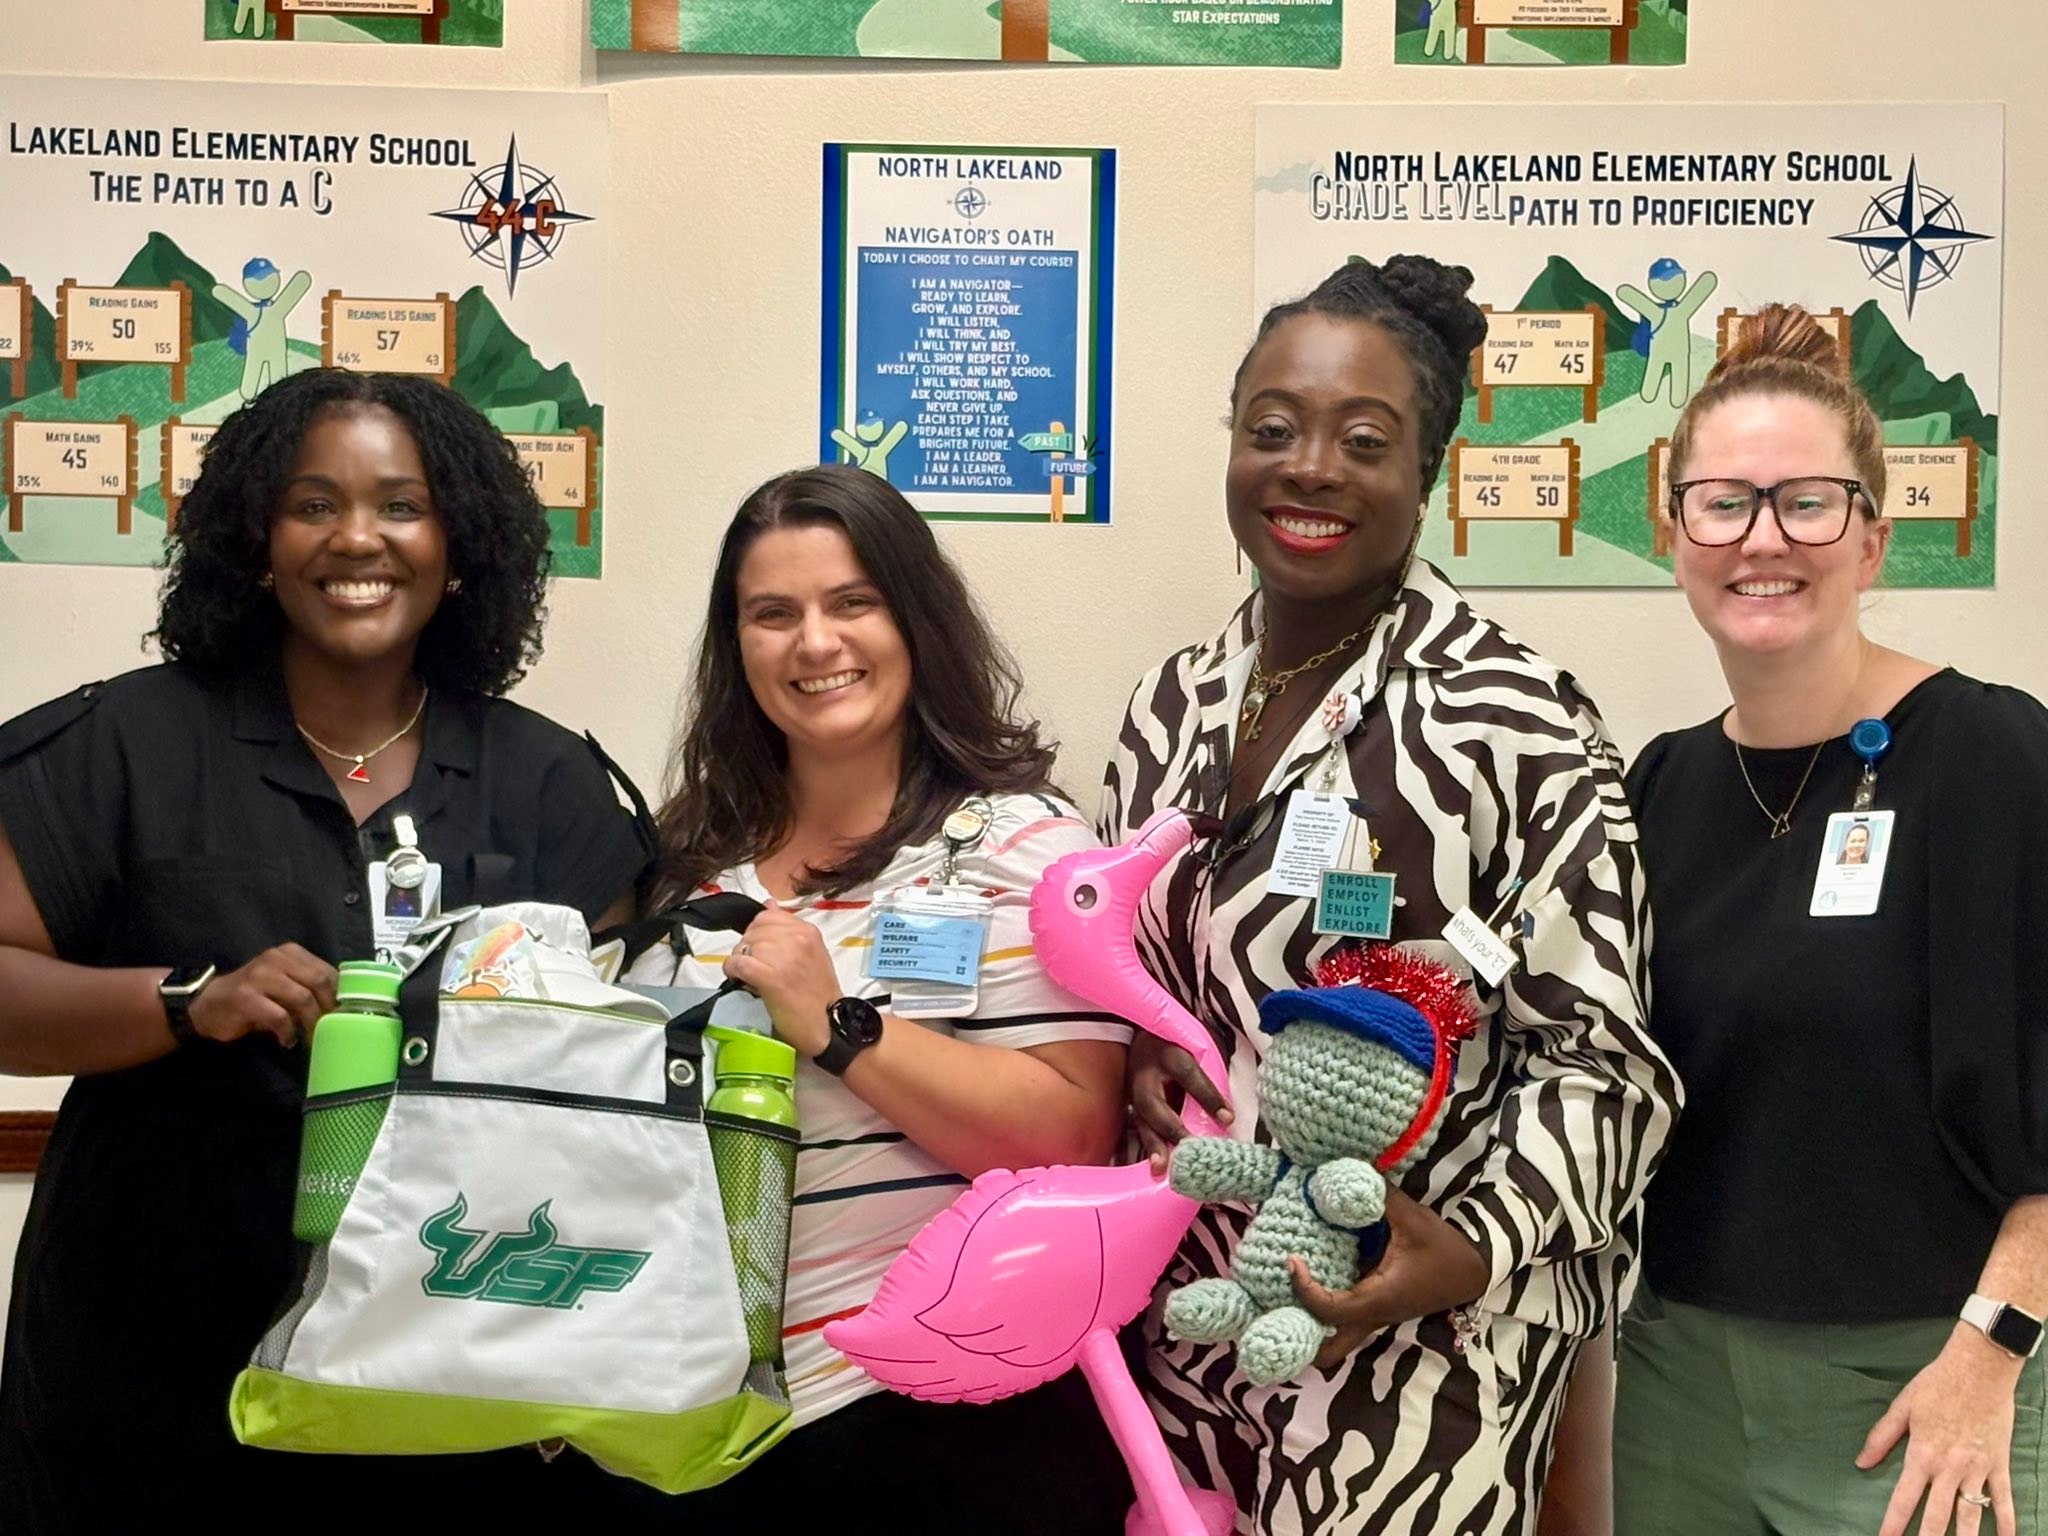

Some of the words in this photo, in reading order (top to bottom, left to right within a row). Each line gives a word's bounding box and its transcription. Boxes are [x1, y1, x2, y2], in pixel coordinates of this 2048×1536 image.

[1172, 10, 1200, 24] STAR
[1202, 11, 1280, 24] EXPECTATIONS
[10, 124, 160, 158] LAKELAND
[172, 128, 359, 164] ELEMENTARY
[370, 134, 476, 168] SCHOOL
[879, 158, 948, 178] NORTH
[957, 159, 1062, 180] LAKELAND
[1335, 152, 1423, 182] NORTH
[1434, 152, 1581, 182] LAKELAND
[1593, 152, 1776, 182] ELEMENTARY
[1787, 152, 1892, 182] SCHOOL
[90, 170, 142, 203] THE
[154, 172, 223, 205] PATH
[235, 178, 268, 206] TO
[280, 180, 298, 208] A
[313, 168, 332, 214] C
[1310, 173, 1408, 220] GRADE
[1420, 181, 1507, 221] LEVEL
[1510, 196, 1578, 226] PATH
[1589, 198, 1621, 226] TO
[1633, 196, 1814, 226] PROFICIENCY
[477, 200, 523, 236] 44
[534, 200, 556, 236] C
[886, 227, 1000, 244] NAVIGATOR'S
[1008, 230, 1054, 246] OATH
[864, 253, 899, 264] TODAY
[902, 254, 906, 264] I
[909, 254, 951, 265] CHOOSE
[954, 255, 969, 265] TO
[972, 255, 1007, 266] CHART
[1010, 256, 1027, 266] MY
[912, 279, 916, 289] I
[919, 279, 936, 290] AM
[939, 279, 947, 290] A
[921, 291, 955, 302] READY
[958, 292, 973, 302] TO
[90, 297, 128, 309] READING
[131, 298, 158, 310] GAINS
[952, 304, 973, 315] AND
[347, 309, 386, 320] READING
[388, 310, 406, 321] L25
[408, 311, 436, 322] GAINS
[930, 316, 935, 326] I
[937, 316, 961, 327] WILL
[112, 318, 135, 339] 50
[1530, 319, 1562, 330] PERIOD
[919, 328, 924, 338] I
[926, 328, 950, 339] WILL
[989, 329, 1011, 340] AND
[71, 340, 94, 352] 39%
[377, 330, 400, 351] 57
[914, 340, 919, 351] I
[922, 340, 945, 351] WILL
[948, 341, 968, 351] TRY
[971, 341, 988, 352] MY
[1488, 340, 1517, 348] READING
[1519, 340, 1534, 348] ACH
[1554, 340, 1574, 348] MATH
[1576, 340, 1590, 348] ACH
[155, 342, 172, 354] 155
[337, 351, 360, 364] 46%
[426, 354, 440, 366] 43
[900, 352, 904, 363] I
[907, 353, 931, 363] WILL
[934, 353, 965, 364] SHOW
[967, 354, 1012, 365] RESPECT
[1015, 354, 1030, 365] TO
[1494, 354, 1518, 374] 47
[1560, 354, 1584, 374] 45
[967, 366, 988, 377] AND
[991, 366, 1008, 377] MY
[915, 377, 919, 387] I
[922, 377, 946, 388] WILL
[949, 377, 980, 389] WORK
[911, 389, 931, 400] ASK
[996, 391, 1018, 402] AND
[926, 402, 959, 413] NEVER
[962, 403, 987, 414] GIVE
[918, 414, 946, 425] EACH
[949, 414, 974, 425] STEP
[976, 415, 981, 426] I
[983, 415, 1009, 426] TAKE
[46, 432, 70, 443] MATH
[73, 433, 101, 444] GAINS
[912, 426, 962, 437] PREPARES
[965, 427, 980, 438] ME
[983, 427, 1004, 438] FOR
[1007, 428, 1015, 438] A
[919, 438, 969, 450] BRIGHTER
[1035, 436, 1060, 446] PAST
[516, 442, 533, 452] ADE
[556, 442, 574, 453] ACH
[62, 448, 86, 469] 45
[926, 451, 931, 461] I
[933, 451, 950, 462] AM
[953, 451, 961, 462] A
[1492, 454, 1510, 464] 4TH
[1512, 455, 1541, 464] GRADE
[1887, 455, 1916, 464] GRADE
[1918, 454, 1956, 464] SCIENCE
[924, 463, 929, 473] I
[932, 463, 949, 474] AM
[952, 463, 959, 474] A
[1050, 462, 1088, 473] FUTURE
[18, 475, 40, 488] 35%
[101, 475, 119, 487] 140
[914, 475, 919, 485] I
[921, 475, 938, 486] AM
[941, 475, 948, 486] A
[1464, 474, 1493, 482] READING
[1495, 474, 1509, 482] ACH
[1530, 474, 1550, 482] MATH
[1552, 474, 1566, 482] ACH
[564, 488, 578, 499] 46
[1476, 486, 1500, 506] 45
[1536, 486, 1559, 506] 50
[1906, 486, 1930, 506] 34
[1328, 874, 1378, 888] ENROLL
[1328, 889, 1378, 903] EMPLOY
[1326, 904, 1370, 917] ENLIST
[1325, 918, 1380, 933] EXPLORE
[882, 934, 918, 942] WELFARE
[878, 959, 918, 967] SECURITY
[420, 1190, 653, 1309] USF
